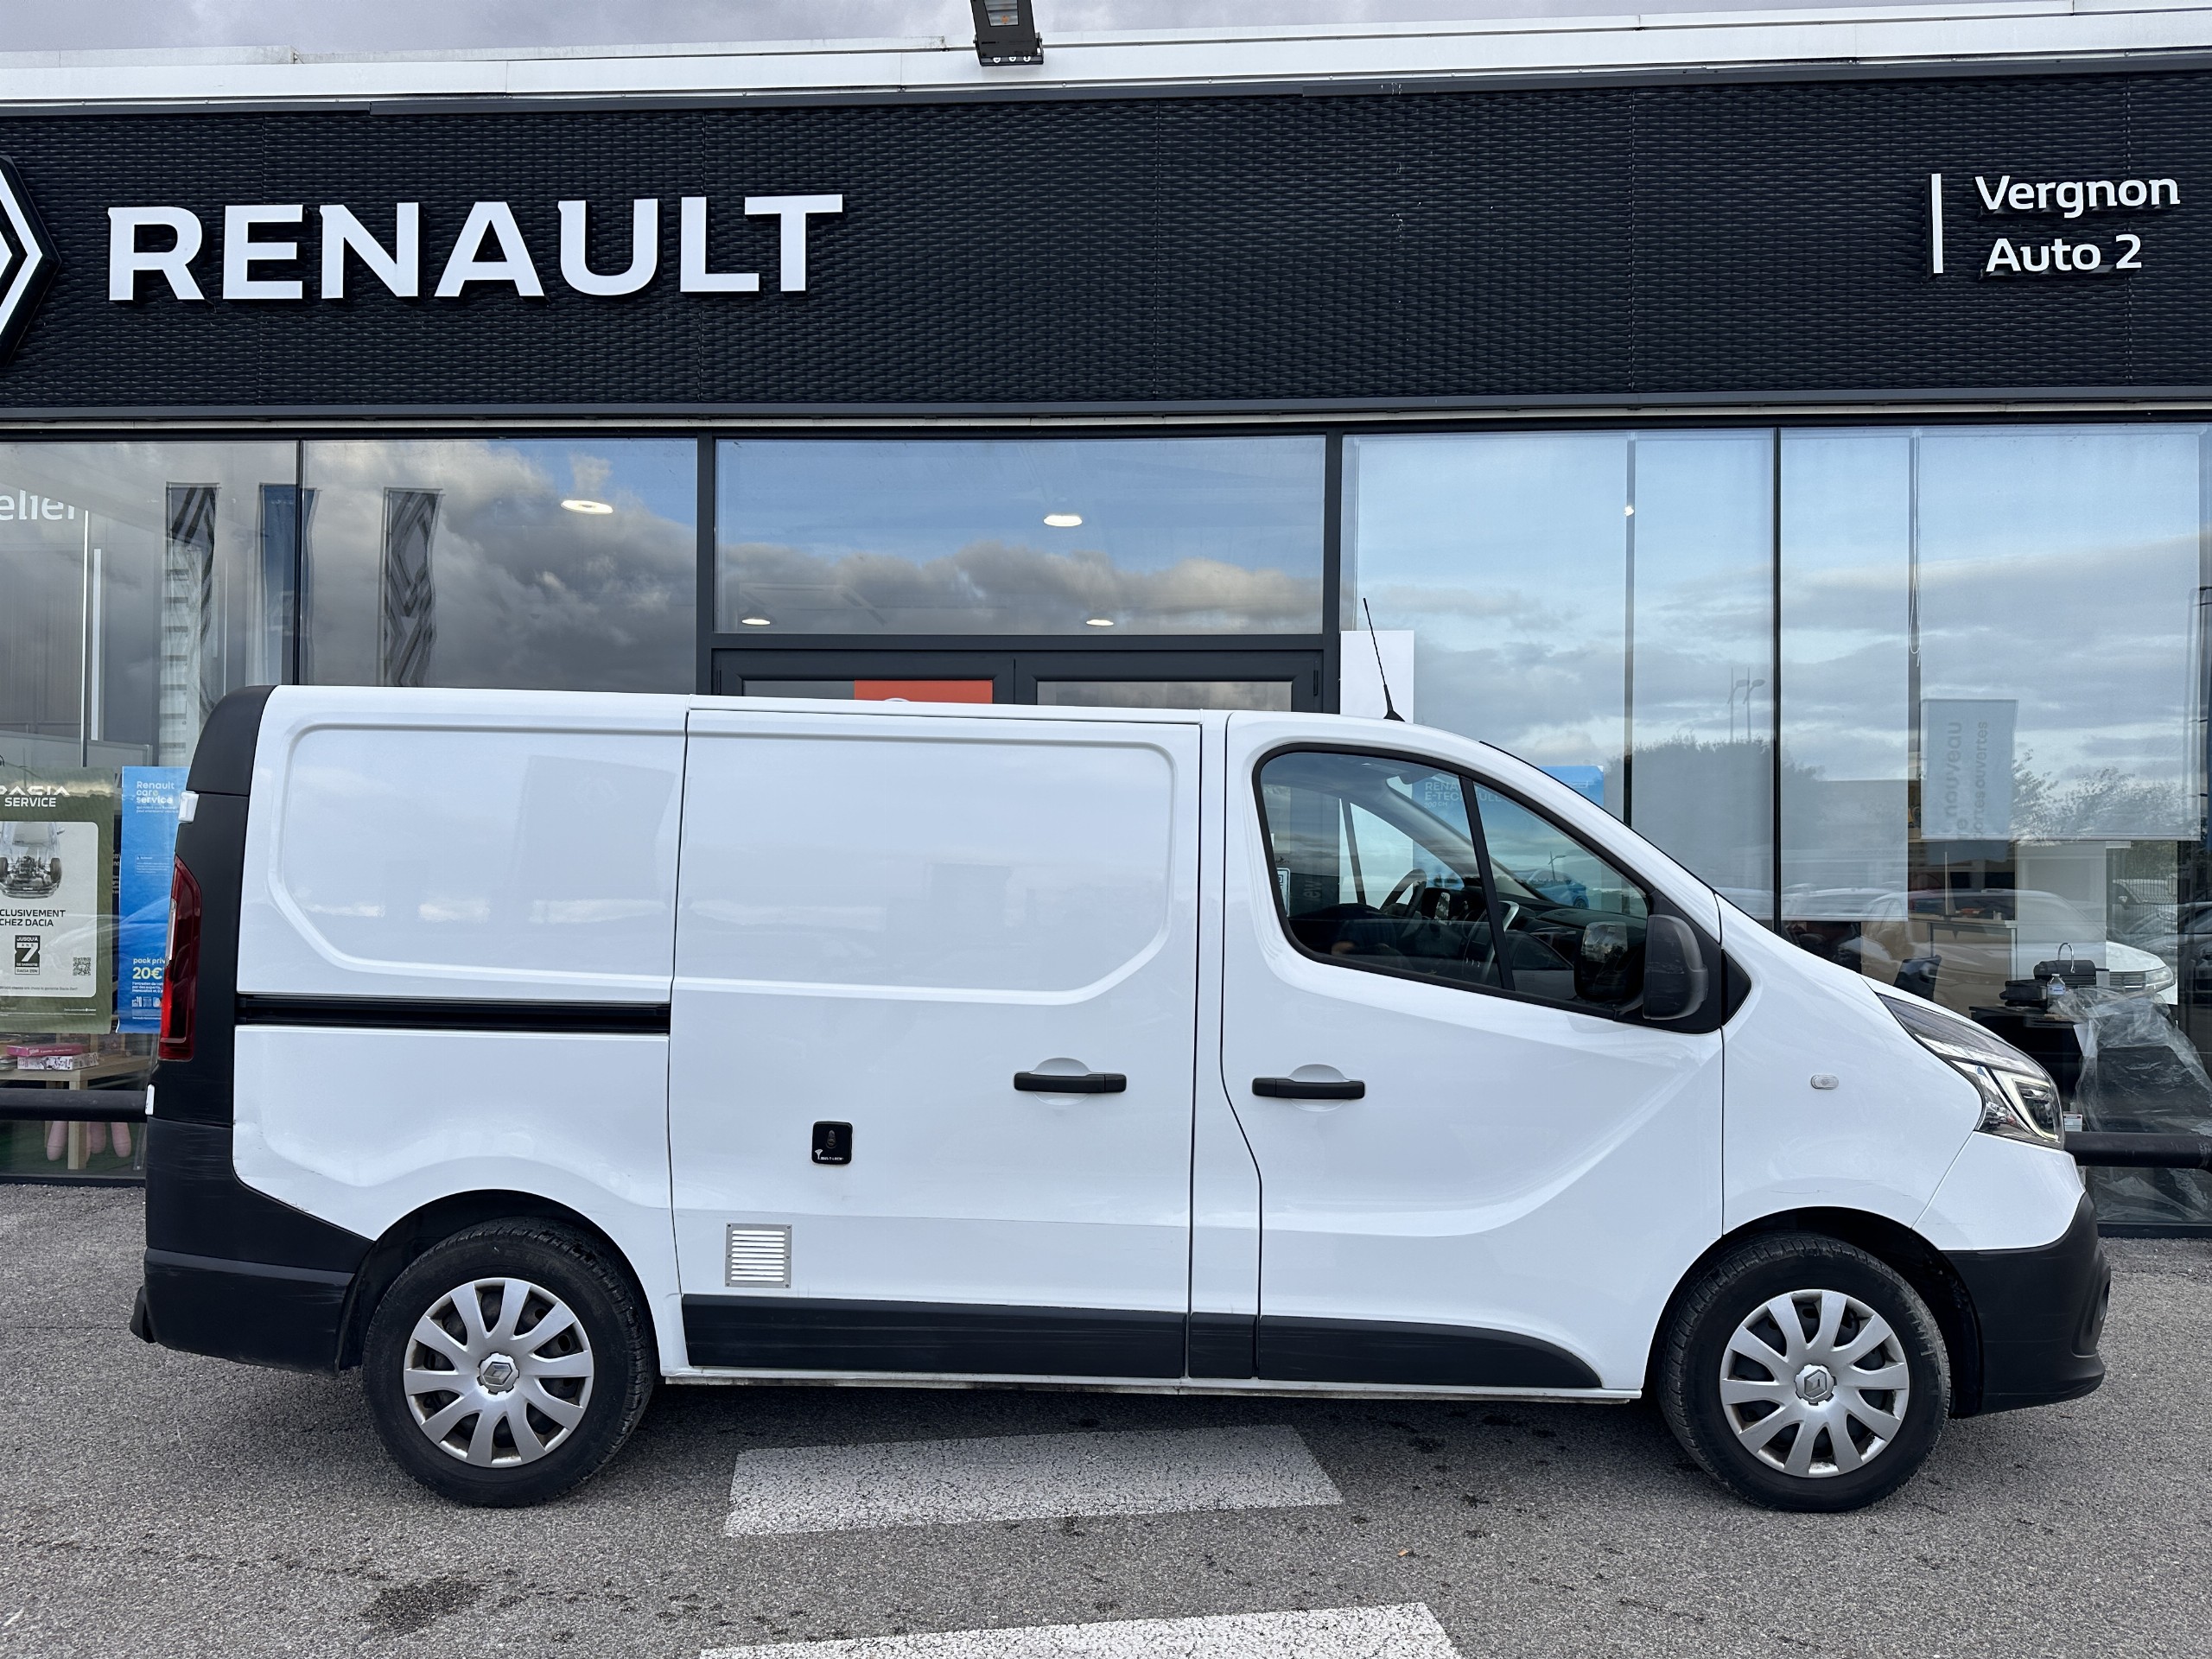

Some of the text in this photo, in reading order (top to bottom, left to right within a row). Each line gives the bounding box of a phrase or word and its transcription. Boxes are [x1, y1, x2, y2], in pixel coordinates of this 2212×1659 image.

[1975, 175, 2180, 218] Vergnon
[108, 194, 843, 301] RENAULT
[1986, 233, 2142, 272] Auto 2
[137, 780, 175, 790] Renault
[1425, 782, 1462, 791] RENA
[136, 795, 174, 804] service
[1424, 791, 1502, 802] E-TEC ULL
[4, 797, 57, 807] SERVICE
[0, 909, 66, 918] CLUSIVEMENT
[25, 918, 54, 927] DACIA
[133, 957, 151, 965] pack
[132, 966, 162, 980] 20€
